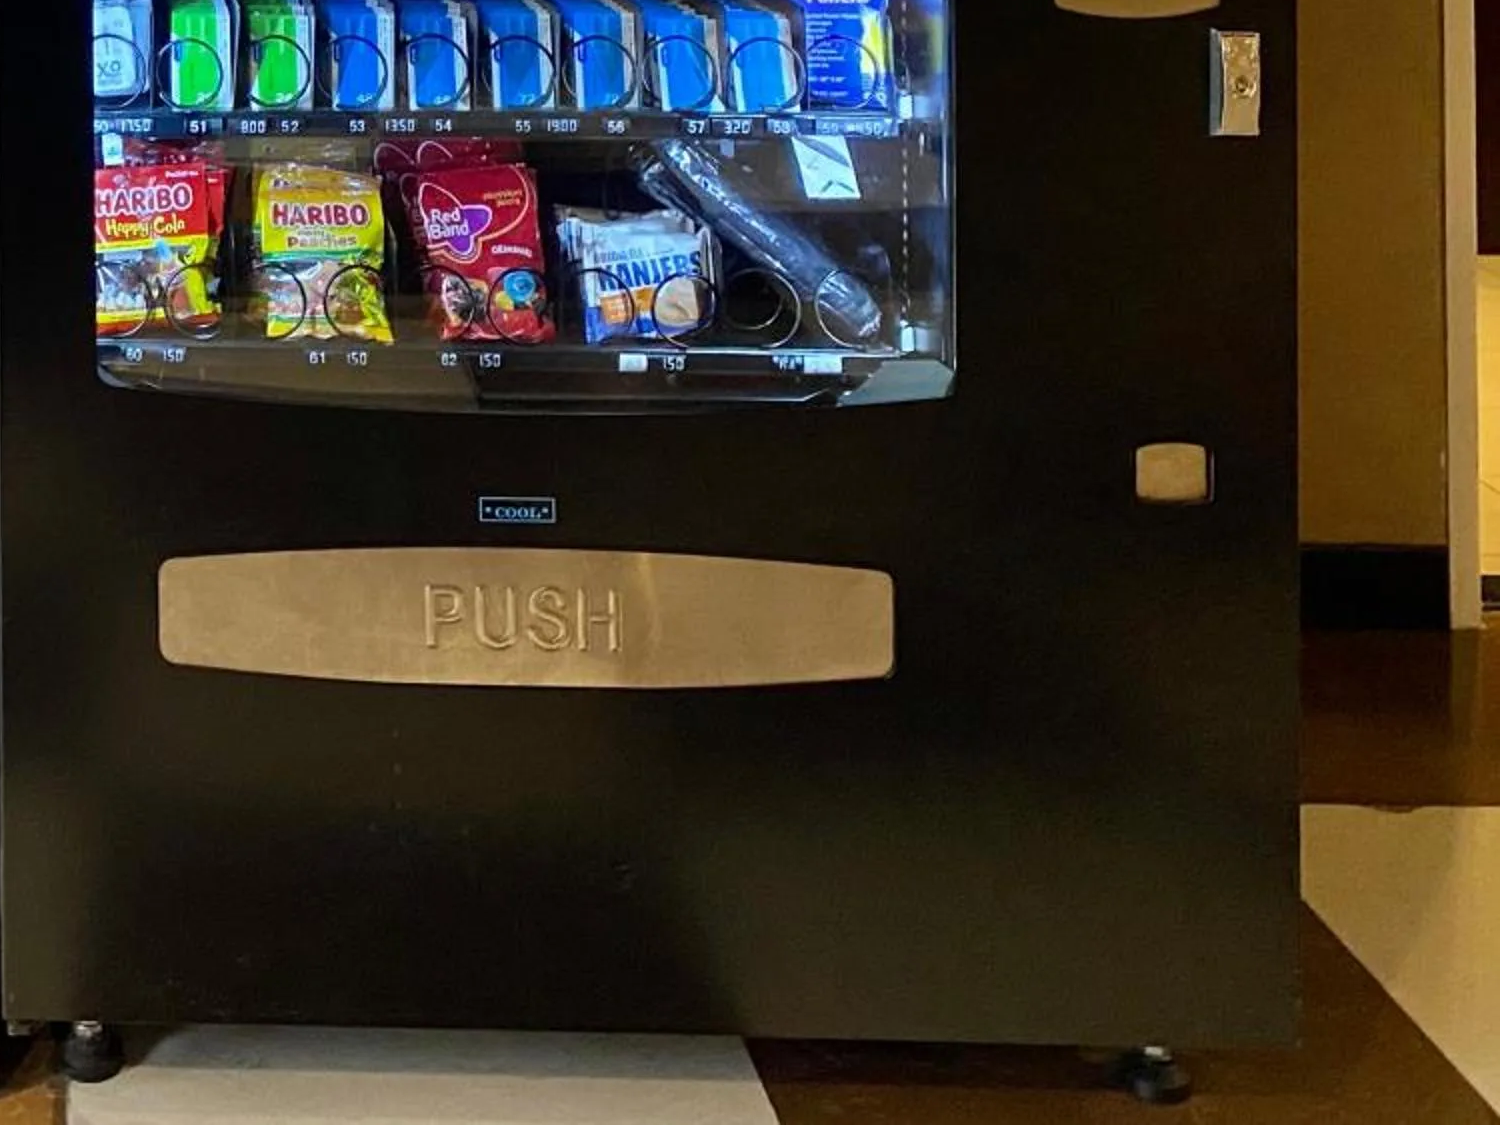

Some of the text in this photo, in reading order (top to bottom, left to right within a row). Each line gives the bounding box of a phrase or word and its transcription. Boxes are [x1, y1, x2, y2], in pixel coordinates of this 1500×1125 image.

[189, 120, 207, 134] 51
[281, 120, 300, 134] 52
[349, 120, 365, 134] 53
[435, 118, 452, 133] 54
[515, 119, 532, 133] 55
[688, 120, 706, 134] 57
[92, 183, 193, 217] HARIBO
[272, 201, 369, 228] HARIBO
[430, 207, 461, 223] Red
[154, 212, 186, 234] Cola
[429, 219, 469, 240] Band
[423, 582, 623, 653] PUSH
